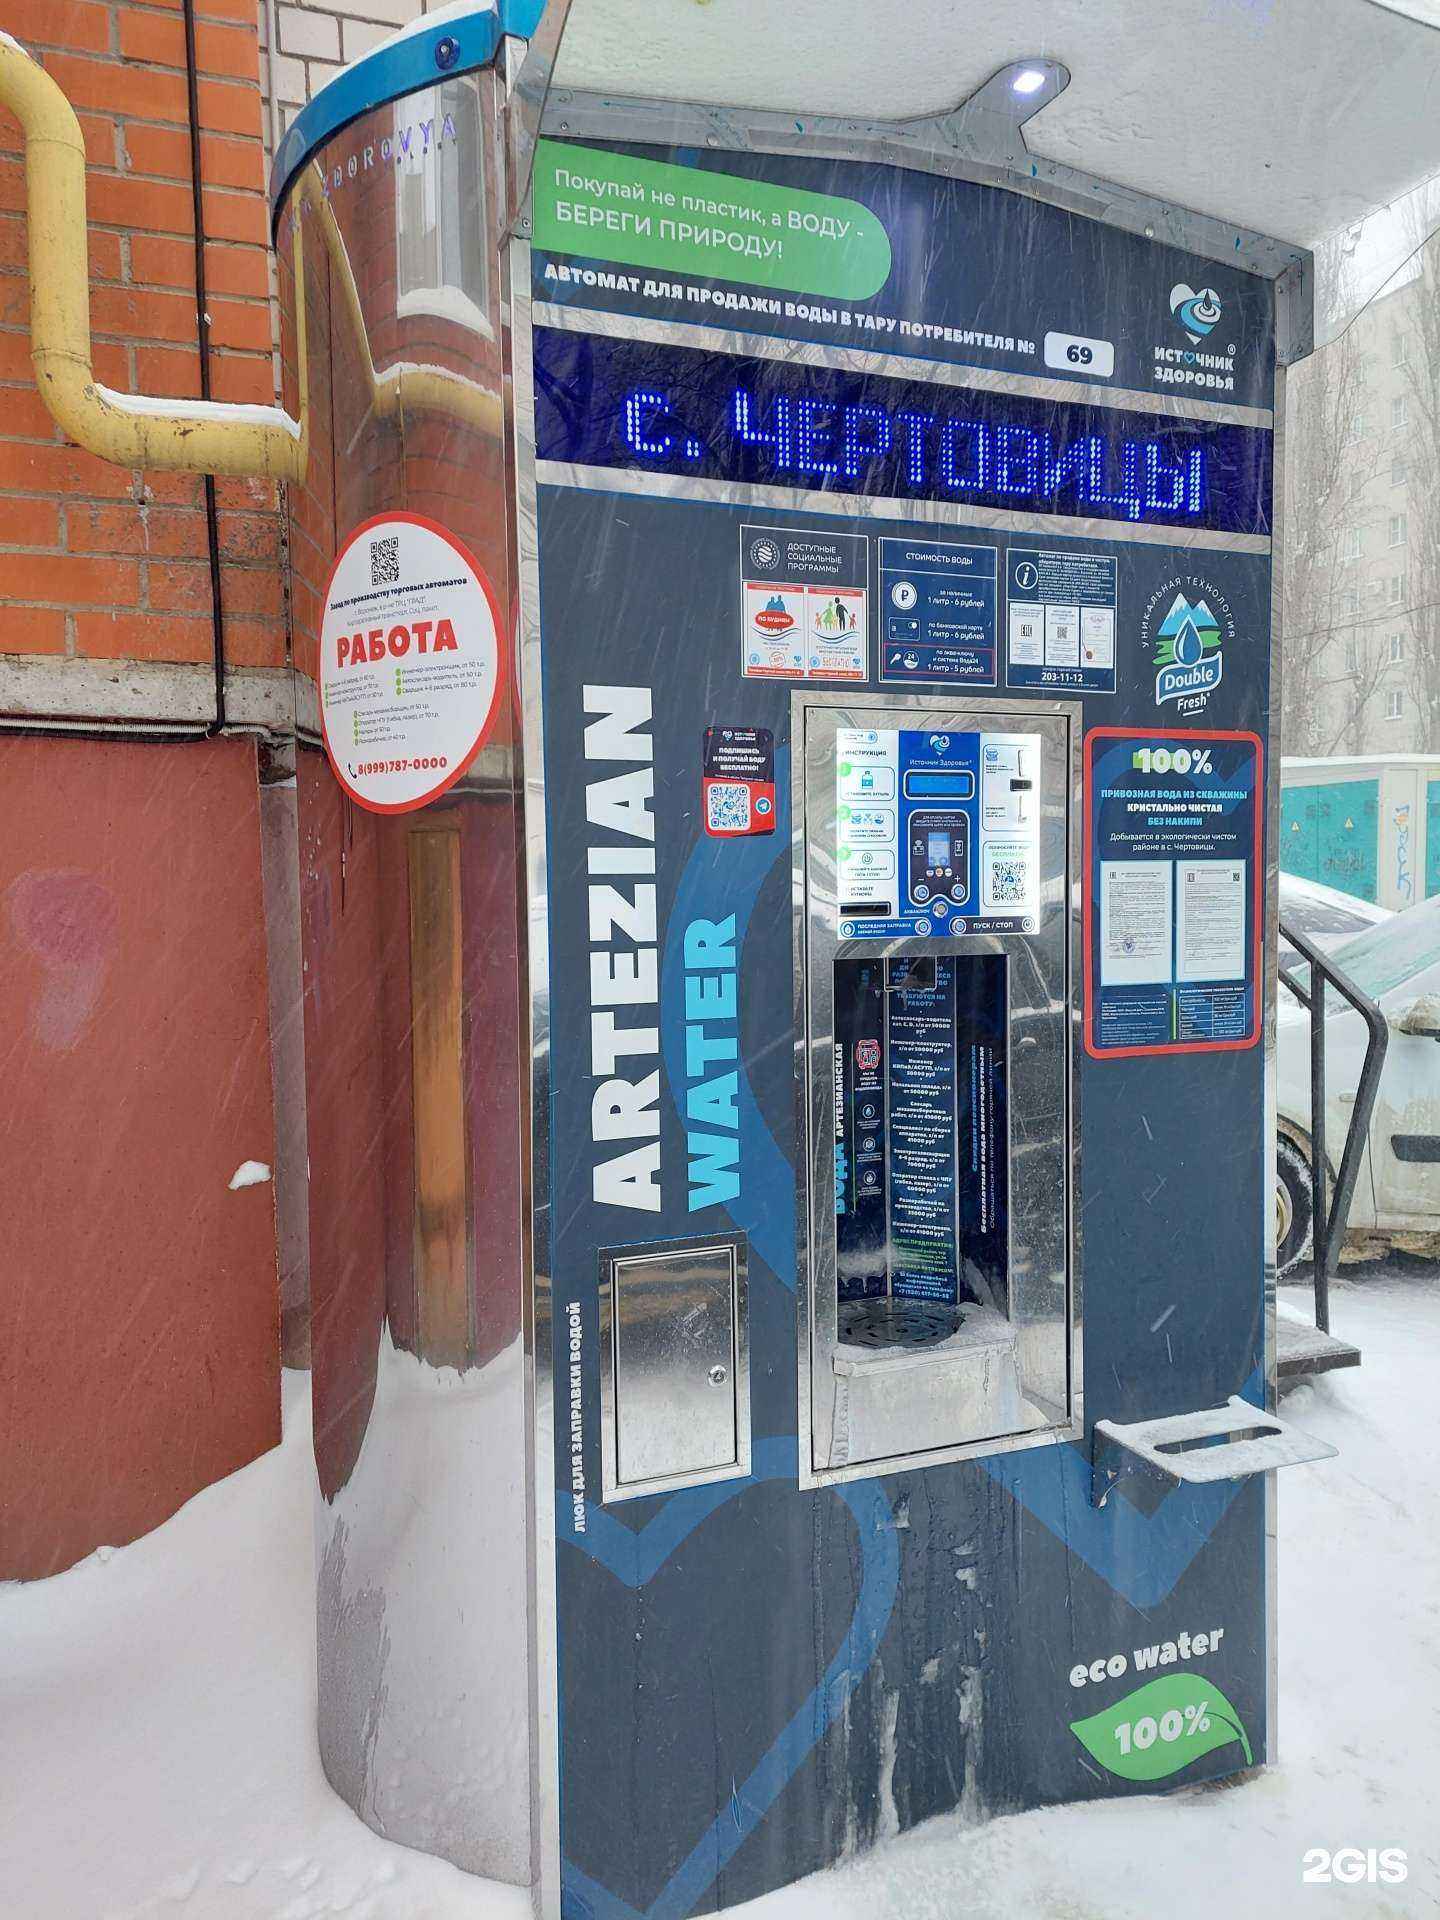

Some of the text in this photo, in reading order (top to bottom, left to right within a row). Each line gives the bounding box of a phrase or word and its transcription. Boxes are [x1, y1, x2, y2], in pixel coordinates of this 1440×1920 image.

[556, 168, 645, 201] Покупай
[651, 189, 676, 207] не
[682, 196, 767, 227] пластик,
[771, 213, 782, 226] а
[788, 210, 851, 240] ВОДУ
[556, 200, 783, 259] БЕРЕГИ ПРИРОДУ!
[545, 264, 1035, 354] АВТОМАТ ДЛЯ ПРОДАЖИ ВОДЫ В ТАРУ ПОТРЕБИТЕЛЯ №
[1066, 344, 1093, 365] 69
[1154, 366, 1234, 390] ЗДОРОВЬЯ
[734, 387, 1203, 520] ЧЕРТОВИЦЫ
[788, 542, 836, 554] ДОСТУПНЫЕ
[788, 553, 842, 564] СОЦИАЛЬНЫЕ
[906, 552, 972, 565] СТОИМОСТЬ ВОДЫ
[788, 563, 839, 573] ПРОГРАММЫ
[351, 589, 390, 606] производству
[391, 584, 424, 596] торговых
[425, 578, 468, 589] автоматов
[932, 598, 950, 606] литр
[960, 600, 985, 608] рублей
[1142, 577, 1181, 648] УНИКАЛЬНАЯ
[1187, 576, 1236, 638] ТЕХНОЛОГИЯ
[336, 619, 458, 669] РАБОТА
[932, 631, 950, 640] литр
[960, 633, 985, 641] рублей
[932, 665, 950, 673] литр
[960, 666, 985, 674] рублей
[1042, 672, 1083, 682] 203-11-12
[1164, 666, 1214, 690] Double
[1177, 693, 1207, 711] Fresh
[358, 756, 447, 776] 8(999)787-0000
[1137, 748, 1213, 774] 100%
[1101, 789, 1248, 799] ПРИВОЗНАЯ ВОДА ИЗ СКВАЖИНЫ
[1127, 803, 1223, 812] КРИСТАЛЬНО ЧИСТАЯ
[1148, 817, 1202, 825] БЕЗ НАКИПИ
[1110, 832, 1154, 842] Добывается
[1161, 833, 1211, 841] экологически
[1132, 842, 1160, 852] районе
[995, 921, 1013, 929] СТОП
[582, 683, 662, 1213] ARTEZIAN
[684, 912, 742, 1211] WATER
[836, 1043, 845, 1138] АРТЕЗИАНСКАЯ
[565, 1302, 586, 1533] ЛЮК ДЛЯ ЗАПРАВКИ ВОДОЙ
[1069, 1628, 1224, 1688] eco water
[1114, 1701, 1210, 1756] 100%
